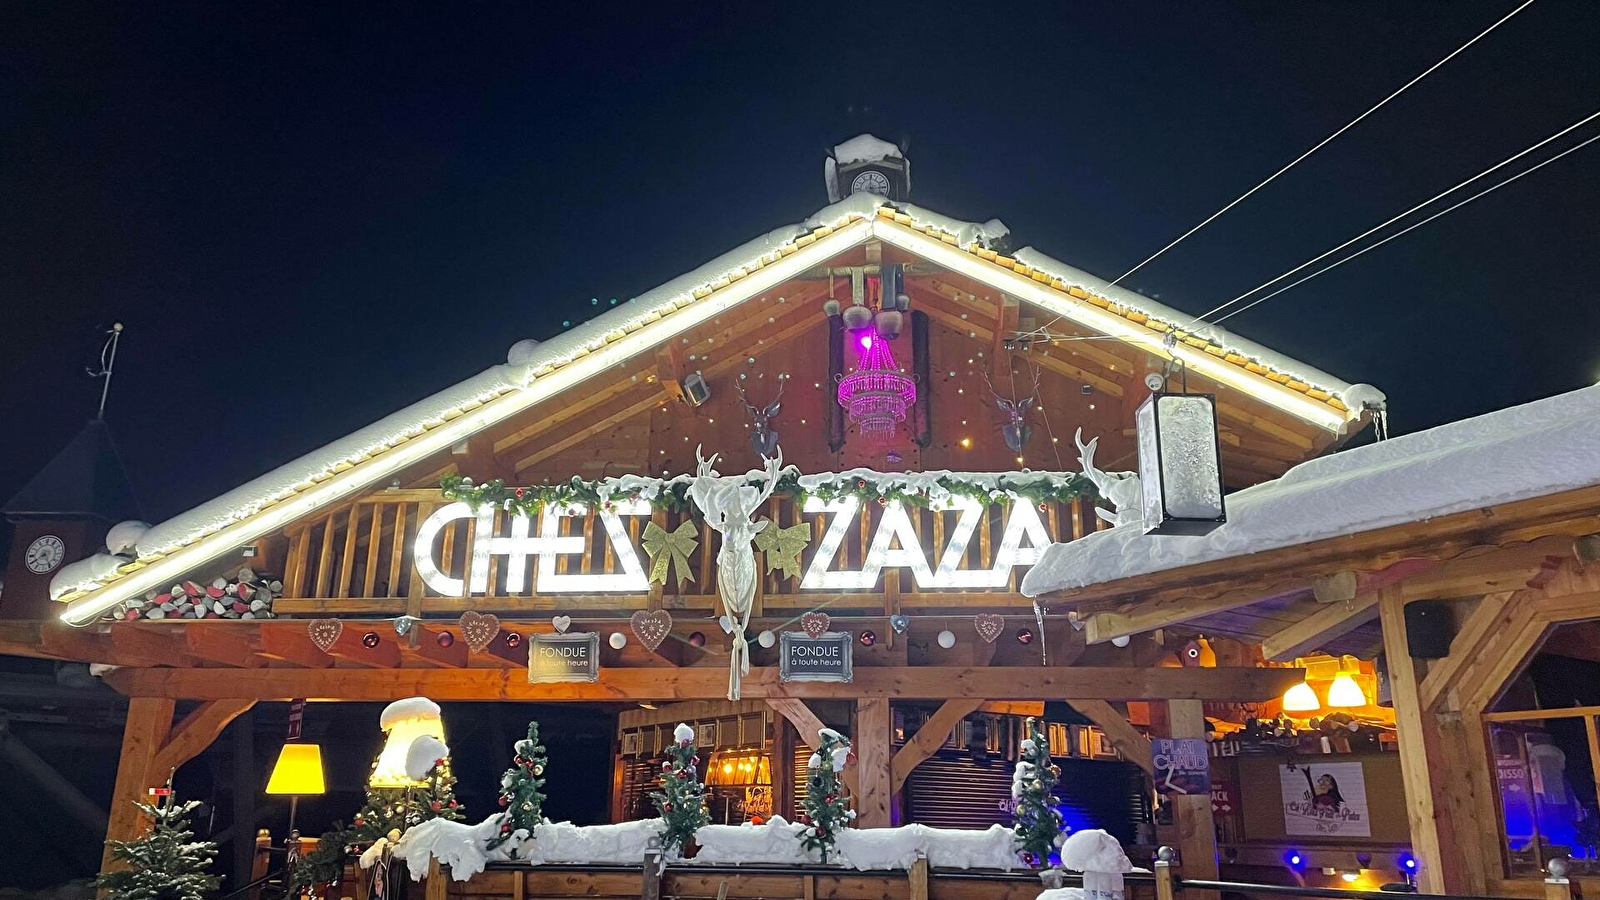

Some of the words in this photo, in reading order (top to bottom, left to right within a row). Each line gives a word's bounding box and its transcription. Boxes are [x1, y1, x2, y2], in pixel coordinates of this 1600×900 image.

[799, 495, 1052, 589] ZAZA
[540, 646, 587, 658] FONDUE
[791, 645, 839, 657] FONDUE
[567, 659, 589, 667] heure
[798, 658, 819, 666] toute
[819, 658, 842, 666] heure
[1160, 739, 1195, 755] PLAT
[1153, 754, 1209, 771] CHAUD
[1211, 790, 1229, 802] ACK
